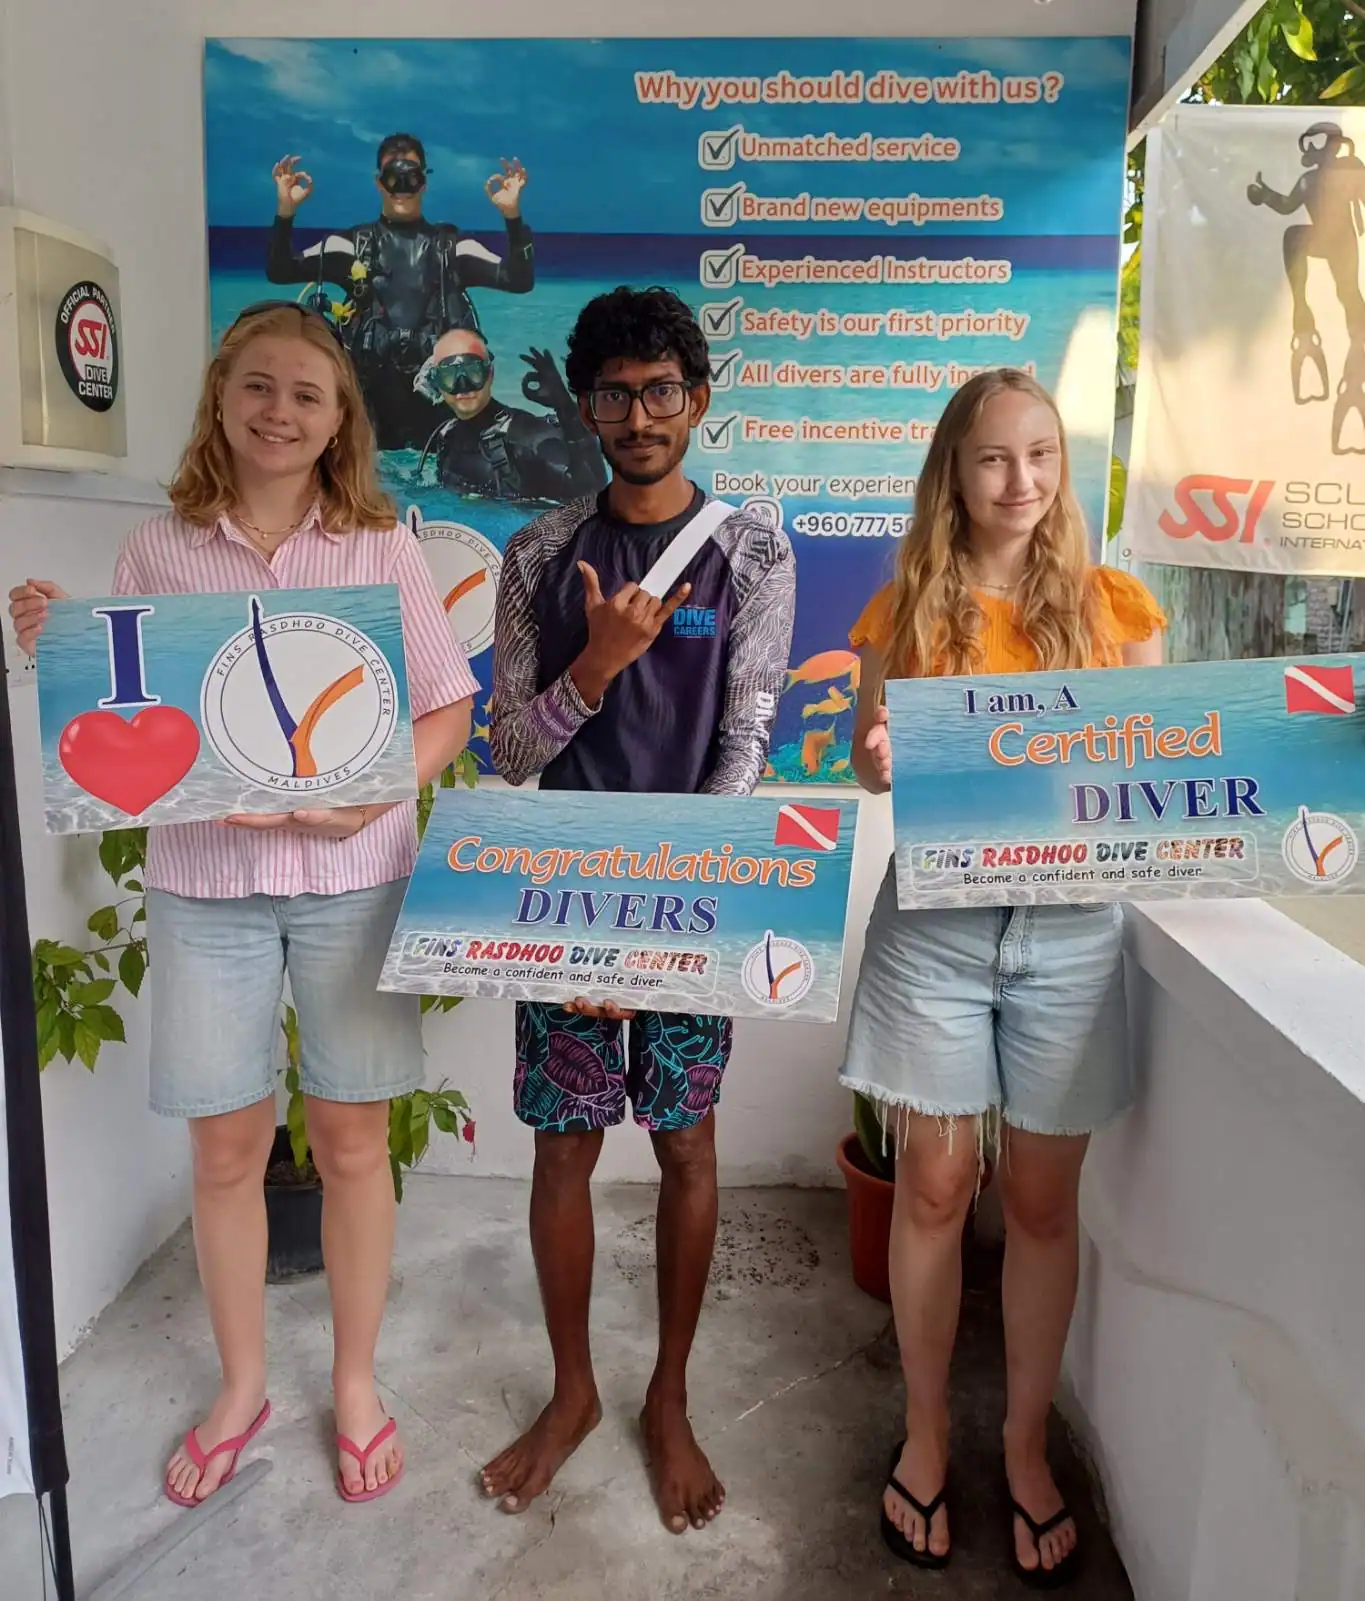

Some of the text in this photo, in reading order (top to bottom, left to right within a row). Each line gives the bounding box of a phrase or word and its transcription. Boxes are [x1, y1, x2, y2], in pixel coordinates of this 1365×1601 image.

[638, 75, 700, 105] Why
[706, 79, 757, 105] you
[766, 75, 860, 100] should
[869, 75, 928, 99] dive
[937, 75, 997, 100] with
[1006, 79, 1038, 99] us
[742, 137, 957, 158] Unmatched service
[743, 196, 1000, 221] Brand new equipments
[742, 260, 1008, 283] Experienced Instructors
[61, 285, 90, 324] OFFICIAL
[743, 311, 1026, 337] Safety is our first priority
[75, 318, 107, 360] SSI
[86, 365, 109, 383] DIVE
[741, 365, 769, 383] All
[777, 365, 842, 384] divers
[850, 369, 885, 385] are
[893, 365, 941, 388] fully
[78, 382, 113, 399] CENTER
[744, 421, 793, 440] Free
[802, 421, 903, 440] incentive
[715, 473, 916, 497] Book your experien
[1158, 474, 1276, 543] SSI
[797, 515, 847, 533] +960
[854, 516, 886, 533] 777
[1280, 536, 1365, 550] INTERNA
[673, 608, 716, 625] DIVE
[673, 626, 716, 636] CAREERS
[95, 608, 158, 706] I
[217, 645, 242, 677] FINS
[335, 628, 367, 653] DIVE
[370, 659, 391, 716] CENTER
[964, 685, 1079, 716] I am, A
[989, 711, 1222, 767] Certified
[267, 767, 351, 788] MALDIVES
[1070, 777, 1266, 822] DIVER
[448, 836, 816, 887] Congratulations
[922, 837, 1245, 870] FINS RASDHOO DIVE CENTER
[963, 865, 1202, 885] Become a confident and safe diver
[512, 888, 718, 934] DIVERS
[416, 936, 708, 975] FINS RASDHOO DIVE CENTER
[443, 962, 664, 987] Become a confident and safe diver
